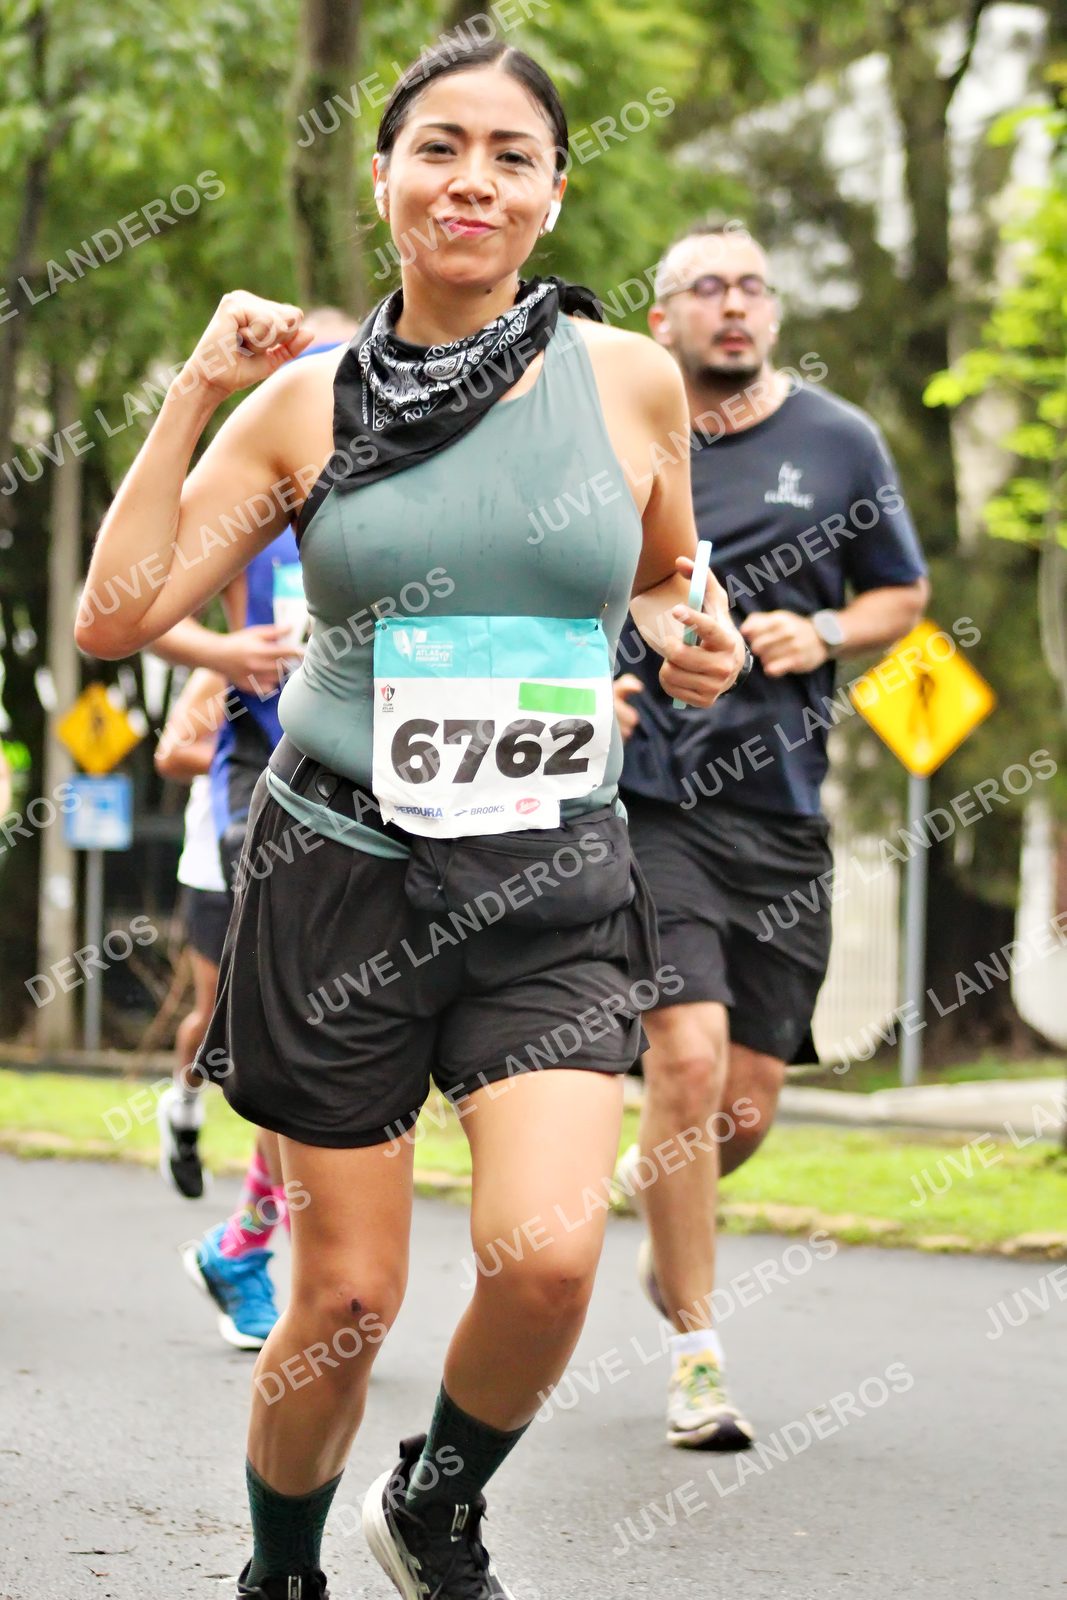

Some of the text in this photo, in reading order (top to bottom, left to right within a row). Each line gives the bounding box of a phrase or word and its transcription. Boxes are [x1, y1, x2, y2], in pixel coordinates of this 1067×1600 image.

[391, 718, 595, 785] 6762
[393, 805, 444, 818] PERDURA
[470, 805, 505, 816] BROOKS
